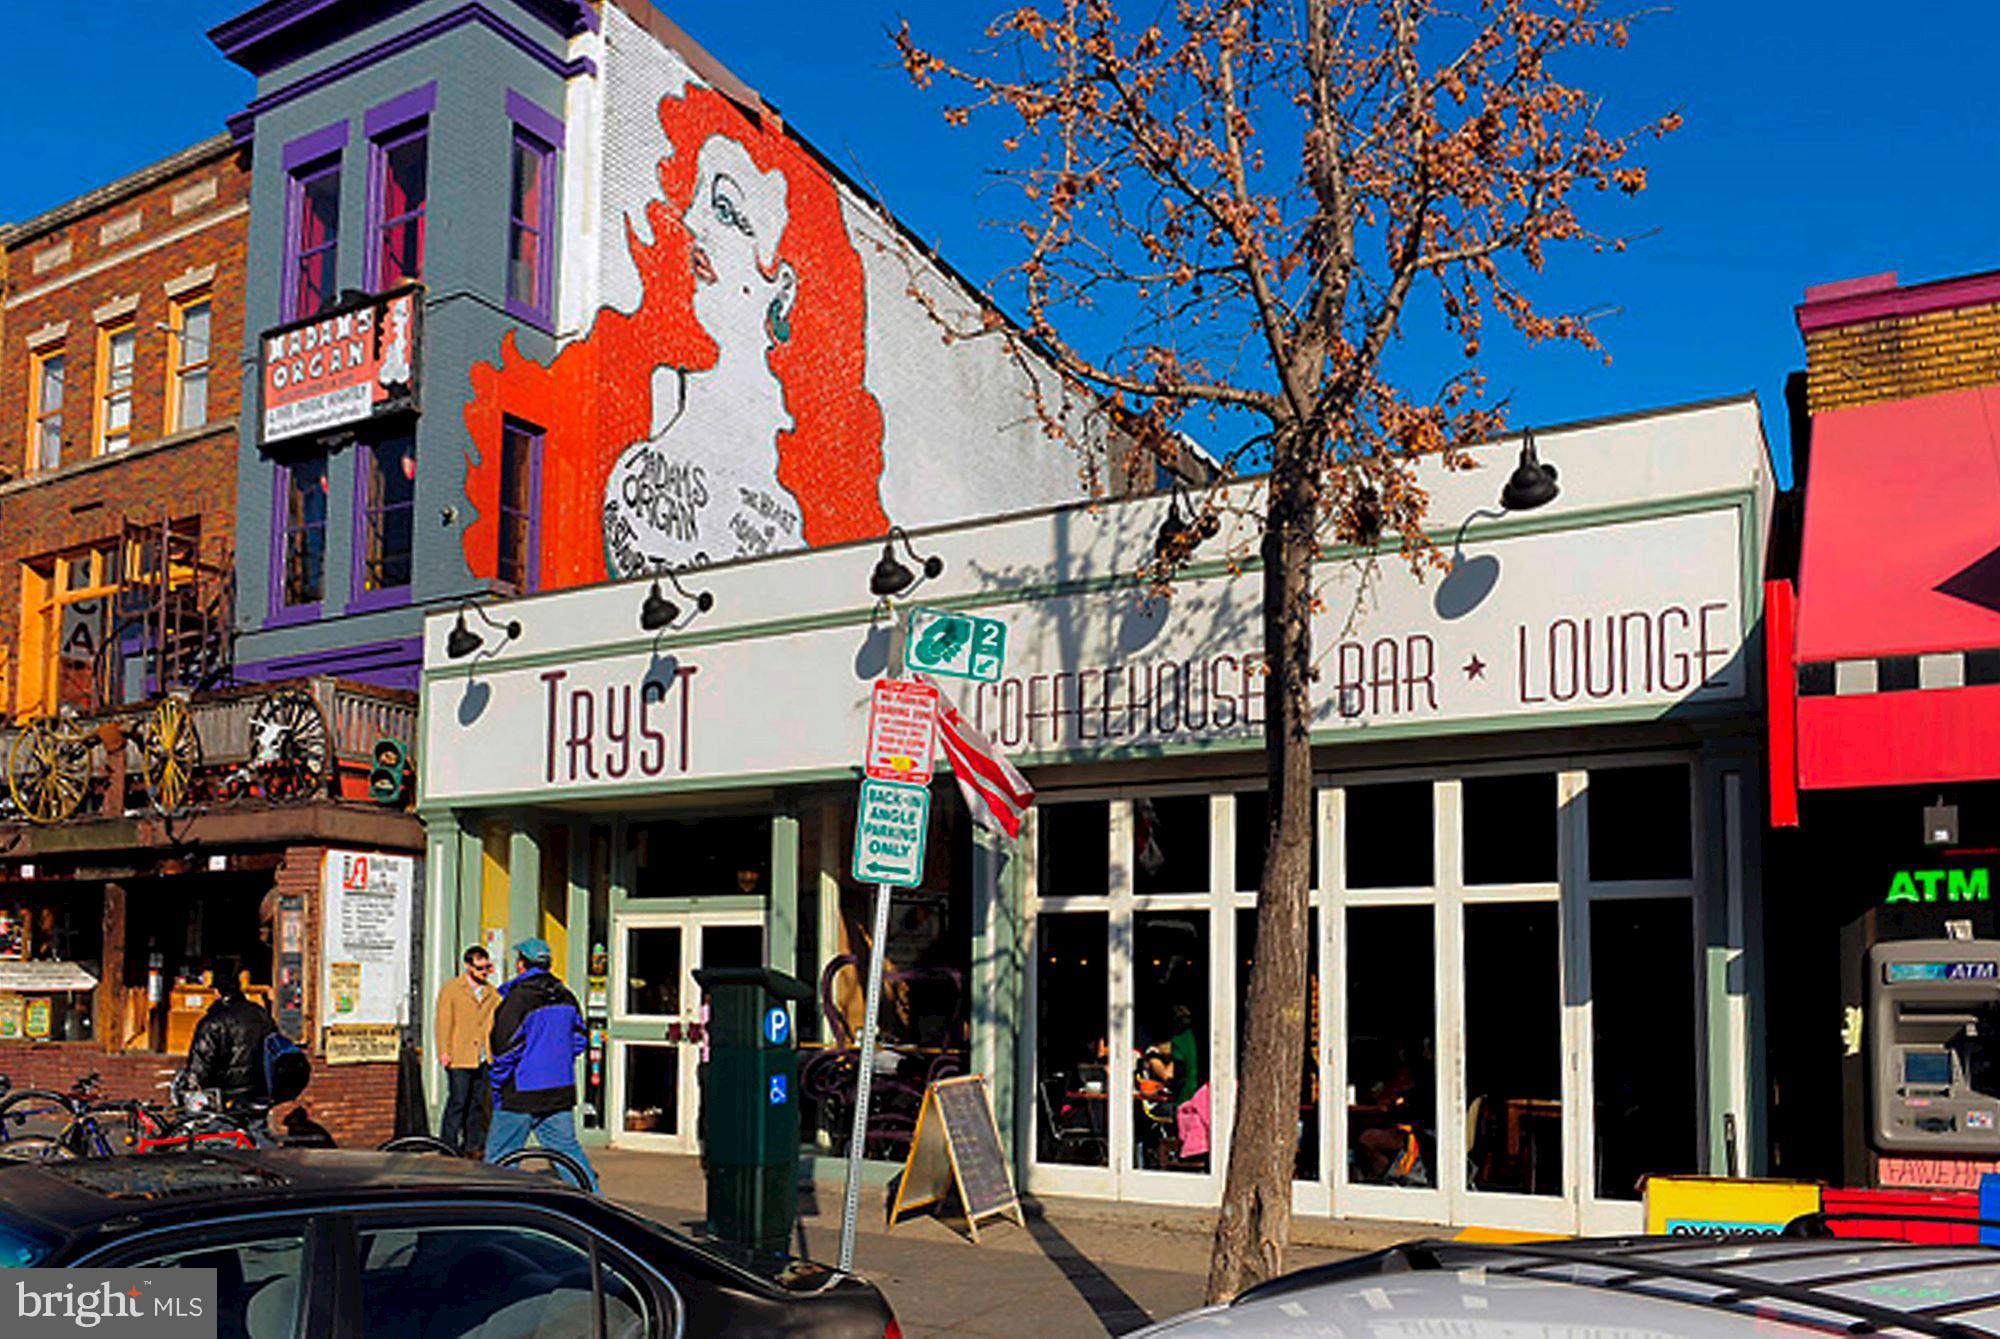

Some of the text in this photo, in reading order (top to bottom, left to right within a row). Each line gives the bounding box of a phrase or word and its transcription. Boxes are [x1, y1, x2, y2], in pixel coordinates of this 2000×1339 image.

[273, 340, 365, 388] ORGAN
[981, 623, 1000, 646] 2
[976, 651, 1267, 746] COFFEEHOUSE
[1334, 634, 1439, 719] BAR
[1518, 603, 1729, 703] LOUNGE
[864, 822, 918, 842] PARKING
[868, 839, 912, 857] ONLY
[1886, 868, 1991, 903] ATM
[1950, 963, 1995, 979] ATM
[771, 1010, 786, 1042] P
